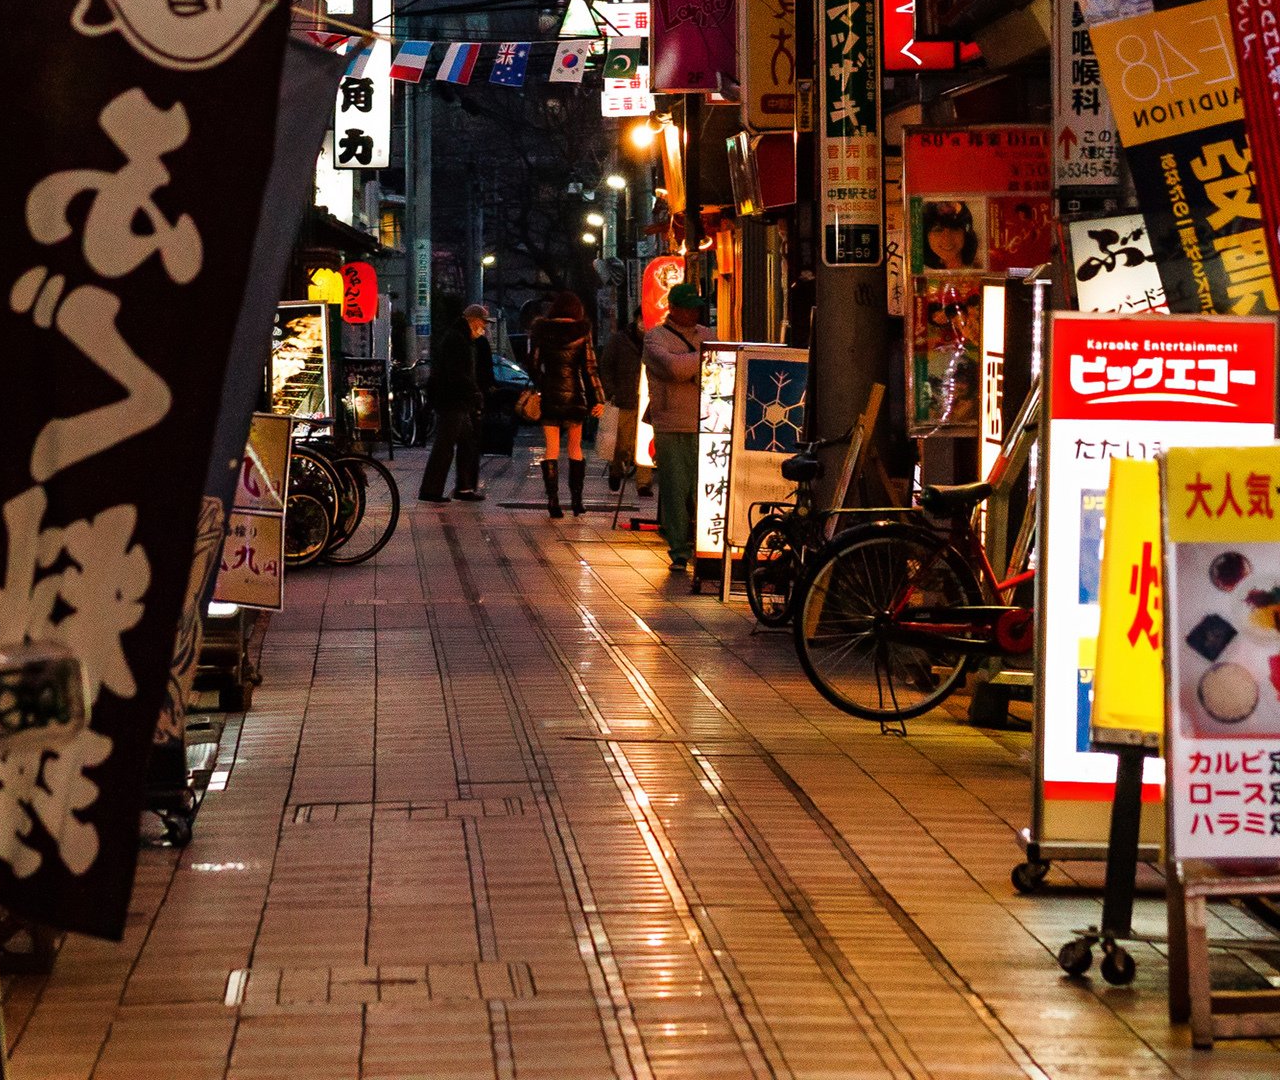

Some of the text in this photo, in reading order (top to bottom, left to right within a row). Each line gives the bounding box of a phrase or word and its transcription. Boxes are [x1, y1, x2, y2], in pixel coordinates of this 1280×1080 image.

[615, 11, 649, 30] 三番
[826, 0, 867, 127] マツザキ
[338, 75, 376, 166] 角力
[826, 144, 840, 182] 管理
[845, 144, 861, 181] 売買
[1086, 338, 1239, 354] Karaoke Entertainment
[1069, 354, 1257, 397] ビッグエコー
[704, 439, 731, 547] 好味亭
